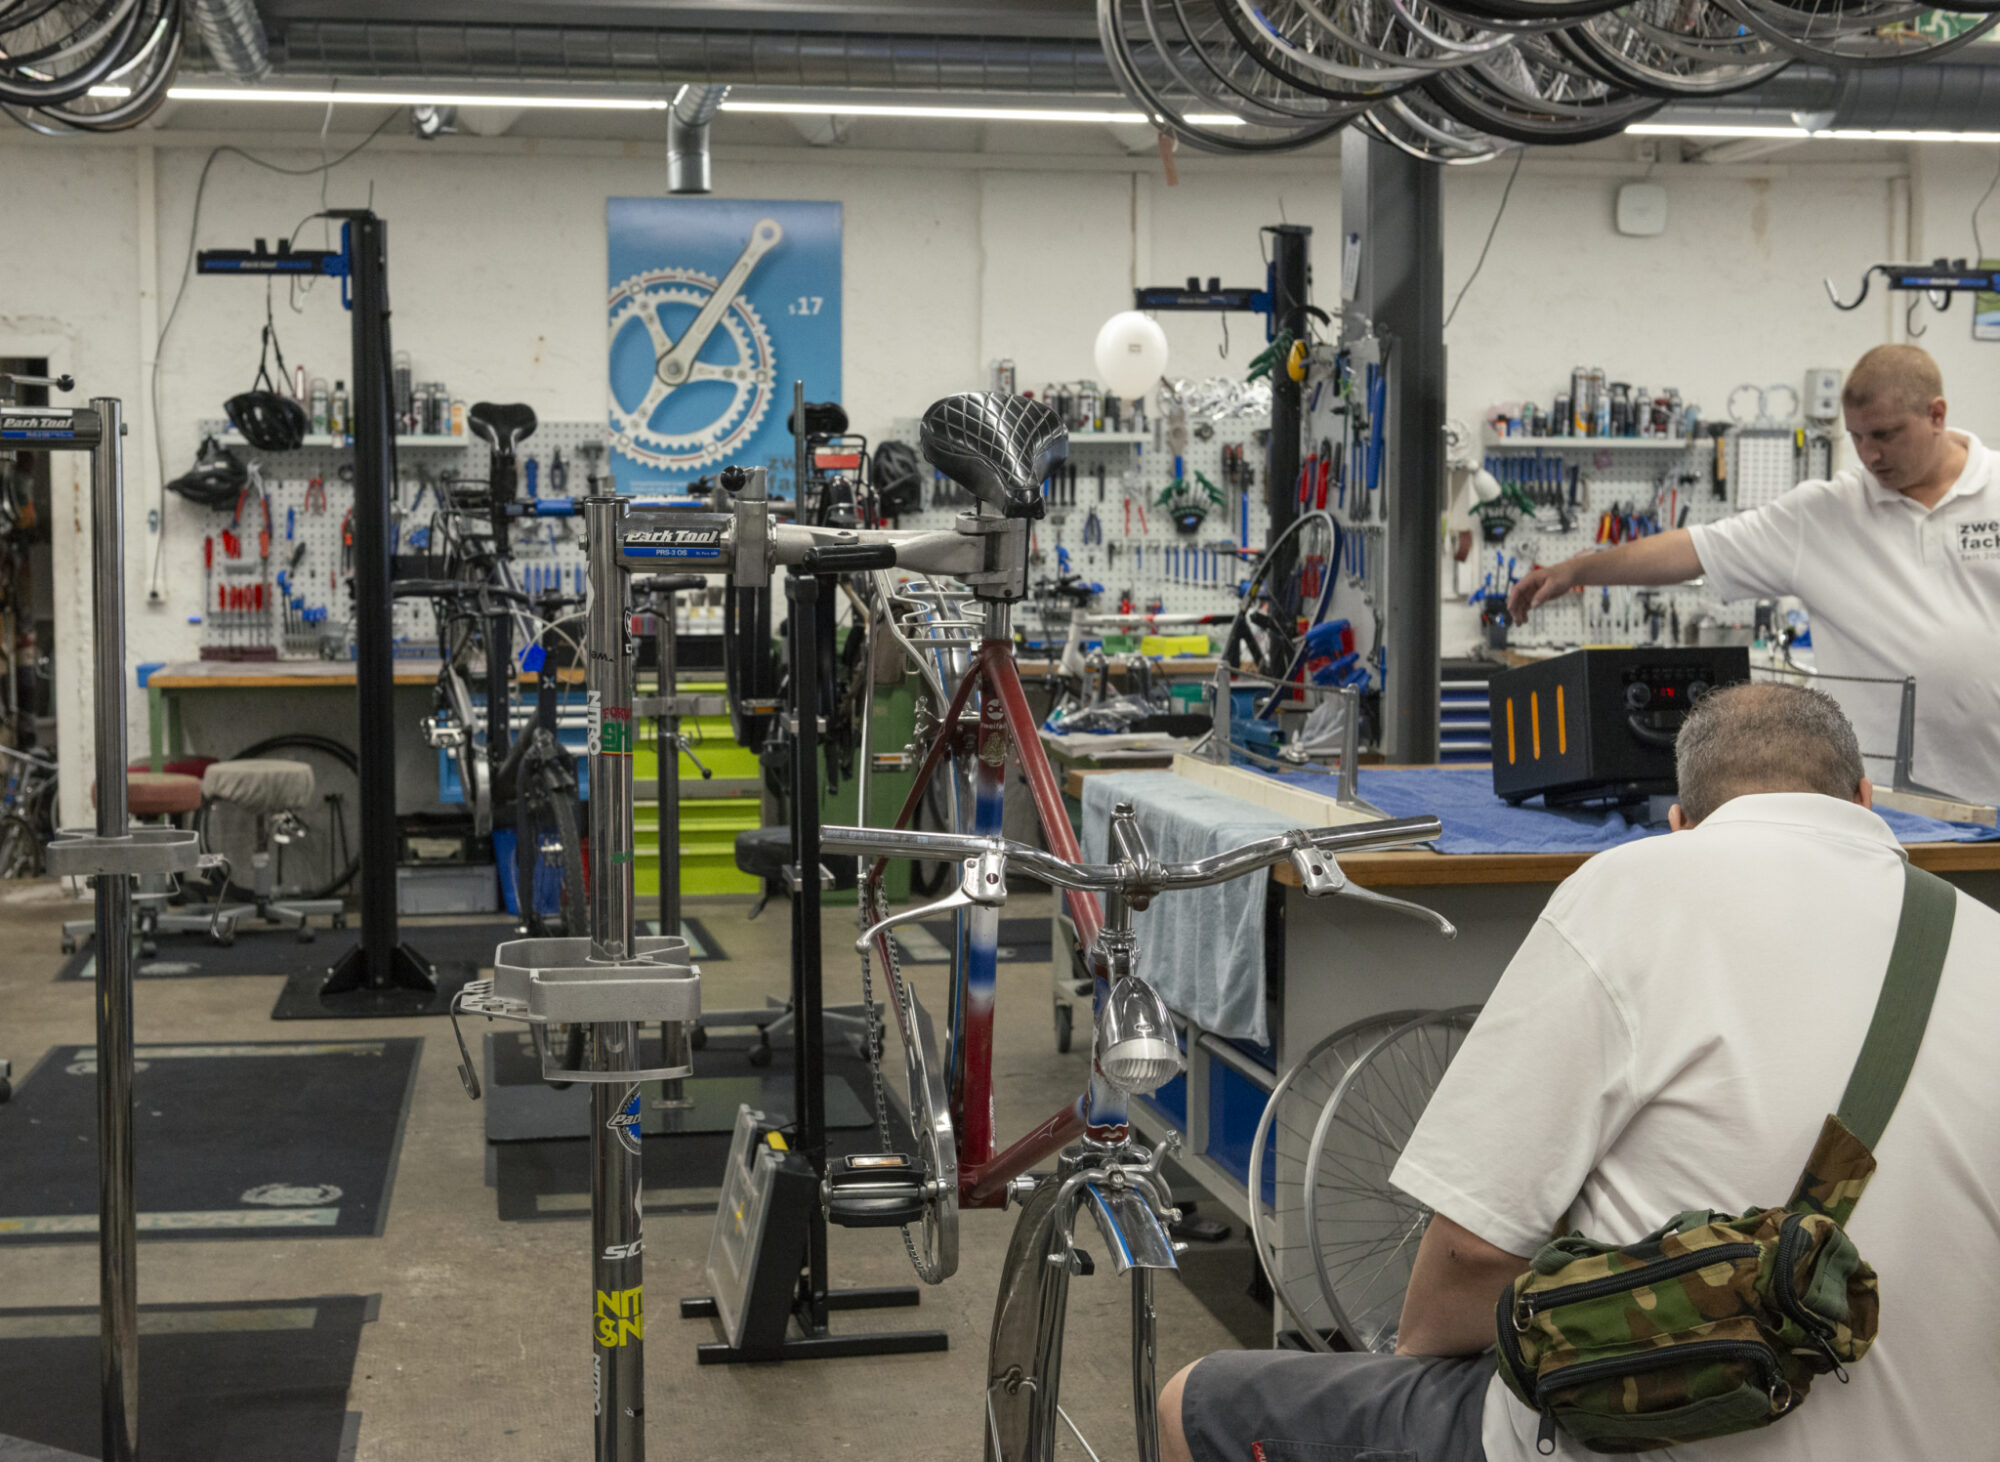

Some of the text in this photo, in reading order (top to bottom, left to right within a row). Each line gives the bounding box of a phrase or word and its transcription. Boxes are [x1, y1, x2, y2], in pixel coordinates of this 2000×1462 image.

[3, 418, 73, 428] Park Tool
[625, 530, 719, 543] Park Tool
[589, 690, 601, 755] NITRO
